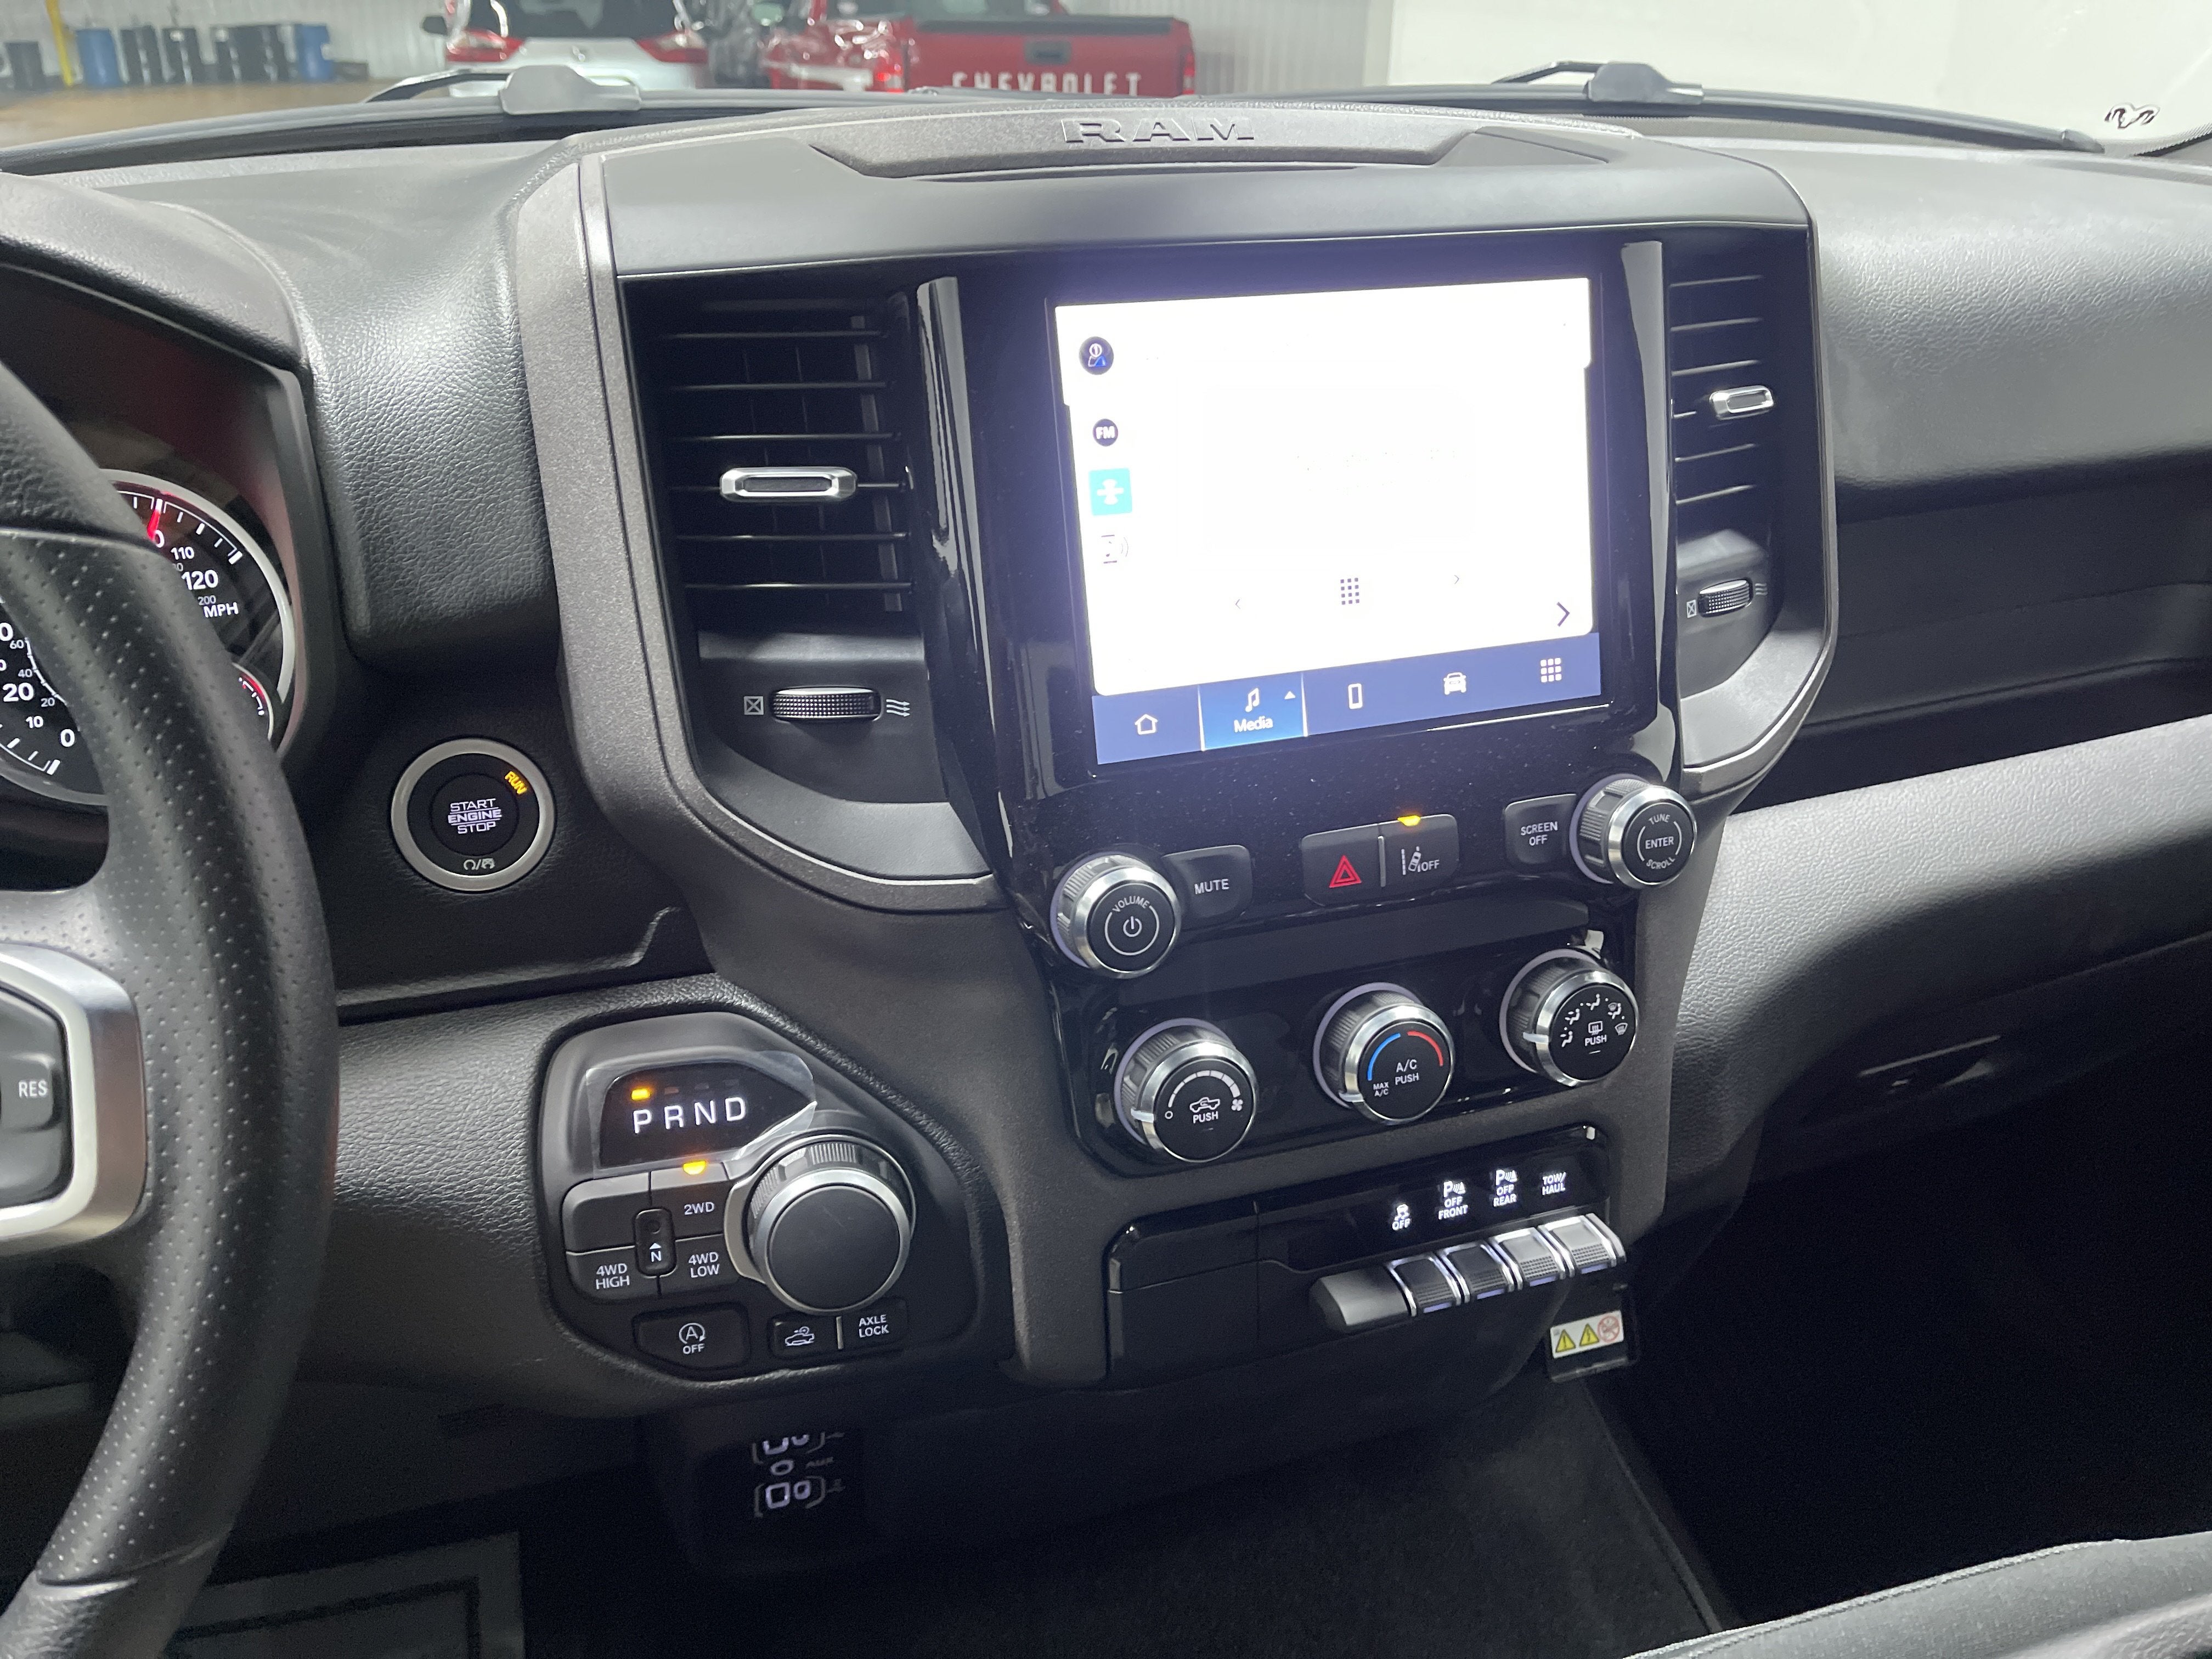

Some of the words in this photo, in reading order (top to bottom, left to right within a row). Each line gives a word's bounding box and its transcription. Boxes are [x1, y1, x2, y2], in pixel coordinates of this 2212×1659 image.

[1060, 117, 1255, 143] RAM
[1096, 425, 1115, 439] FM
[170, 546, 195, 560] 110
[181, 569, 219, 590] 120
[198, 595, 216, 606] 200
[203, 602, 239, 618] MPH
[9, 639, 25, 650] 60
[18, 668, 32, 678] 40
[2, 682, 35, 702] 20
[41, 697, 55, 707] 20
[25, 715, 44, 729] 10
[1233, 715, 1273, 733] Media
[60, 729, 76, 747] 0
[504, 771, 528, 795] RUN
[450, 798, 496, 812] START
[447, 809, 502, 823] ENGINE
[1648, 813, 1671, 825] TUNE
[457, 821, 496, 834] STOP
[1520, 821, 1558, 836] SCREEN
[1528, 834, 1548, 847] OFF
[1645, 836, 1674, 849] ENTER
[1421, 859, 1440, 872] OFF
[1646, 857, 1676, 870] SCROLL
[1194, 878, 1230, 895] MUTE
[1112, 895, 1150, 913] VOLUME
[1584, 1034, 1607, 1047] PUSH
[1396, 1058, 1418, 1073] A/C
[1373, 1081, 1389, 1091] MAX
[1395, 1072, 1420, 1086] PUSH
[18, 1080, 48, 1098] RES
[1374, 1088, 1389, 1097] A/C
[1193, 1110, 1218, 1124] PUSH
[1496, 1183, 1514, 1196] OFF
[1542, 1182, 1566, 1195] HAUL
[1444, 1195, 1463, 1208] OFF
[1493, 1193, 1517, 1207] REAR
[684, 1201, 715, 1215] 2WD
[1437, 1204, 1469, 1220] FRONT
[1391, 1218, 1411, 1231] OFF
[651, 1250, 662, 1262] N
[688, 1251, 719, 1265] 4WD
[596, 1263, 628, 1277] 4WD
[690, 1263, 720, 1278] LOW
[595, 1275, 630, 1290] HIGH
[858, 1314, 888, 1327] AXLE
[858, 1324, 890, 1339] LOCK
[682, 1342, 706, 1355] OFF
